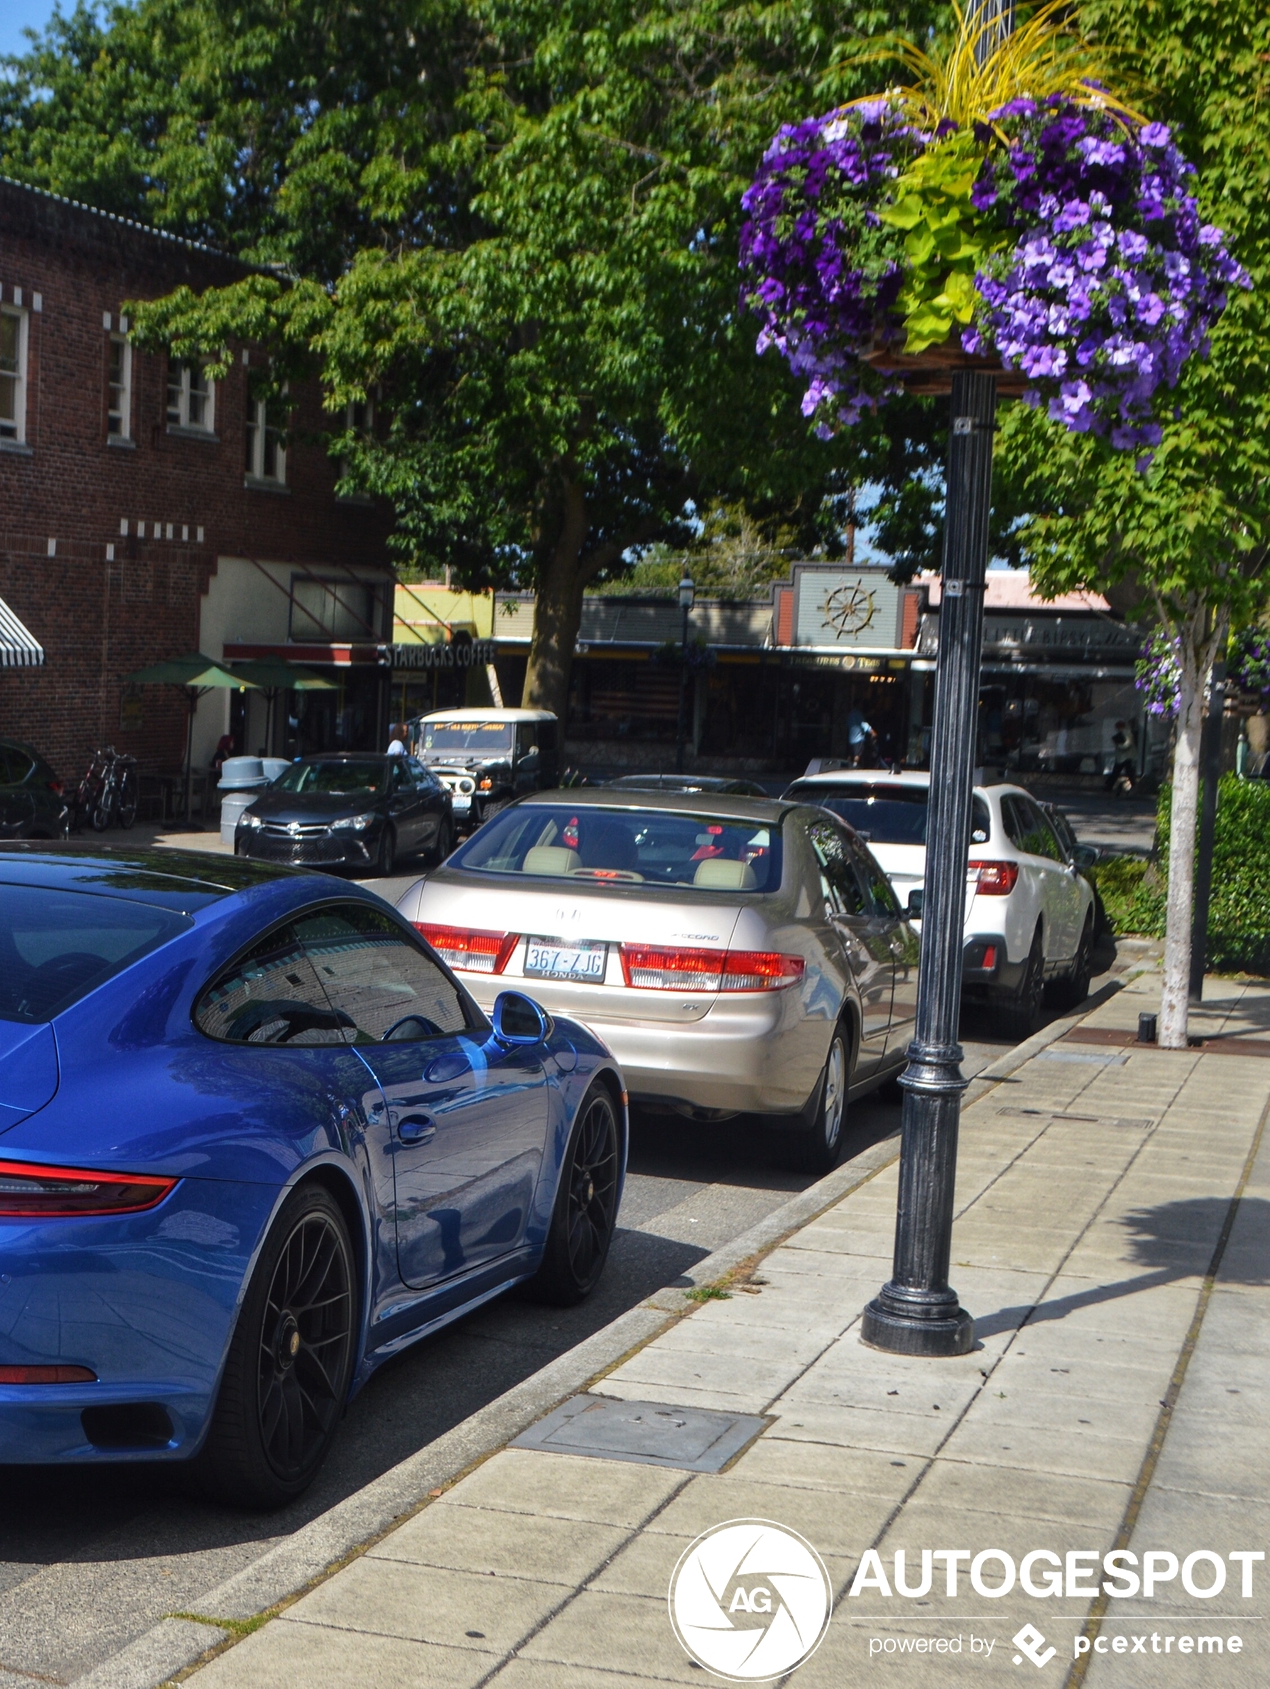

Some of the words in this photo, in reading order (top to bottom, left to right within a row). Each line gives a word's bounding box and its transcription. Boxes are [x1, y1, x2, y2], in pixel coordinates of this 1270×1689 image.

[385, 644, 454, 667] STARBUCKS
[456, 644, 495, 667] COFFEE
[529, 949, 602, 974] 367-ZJG
[541, 970, 585, 980] HONDA
